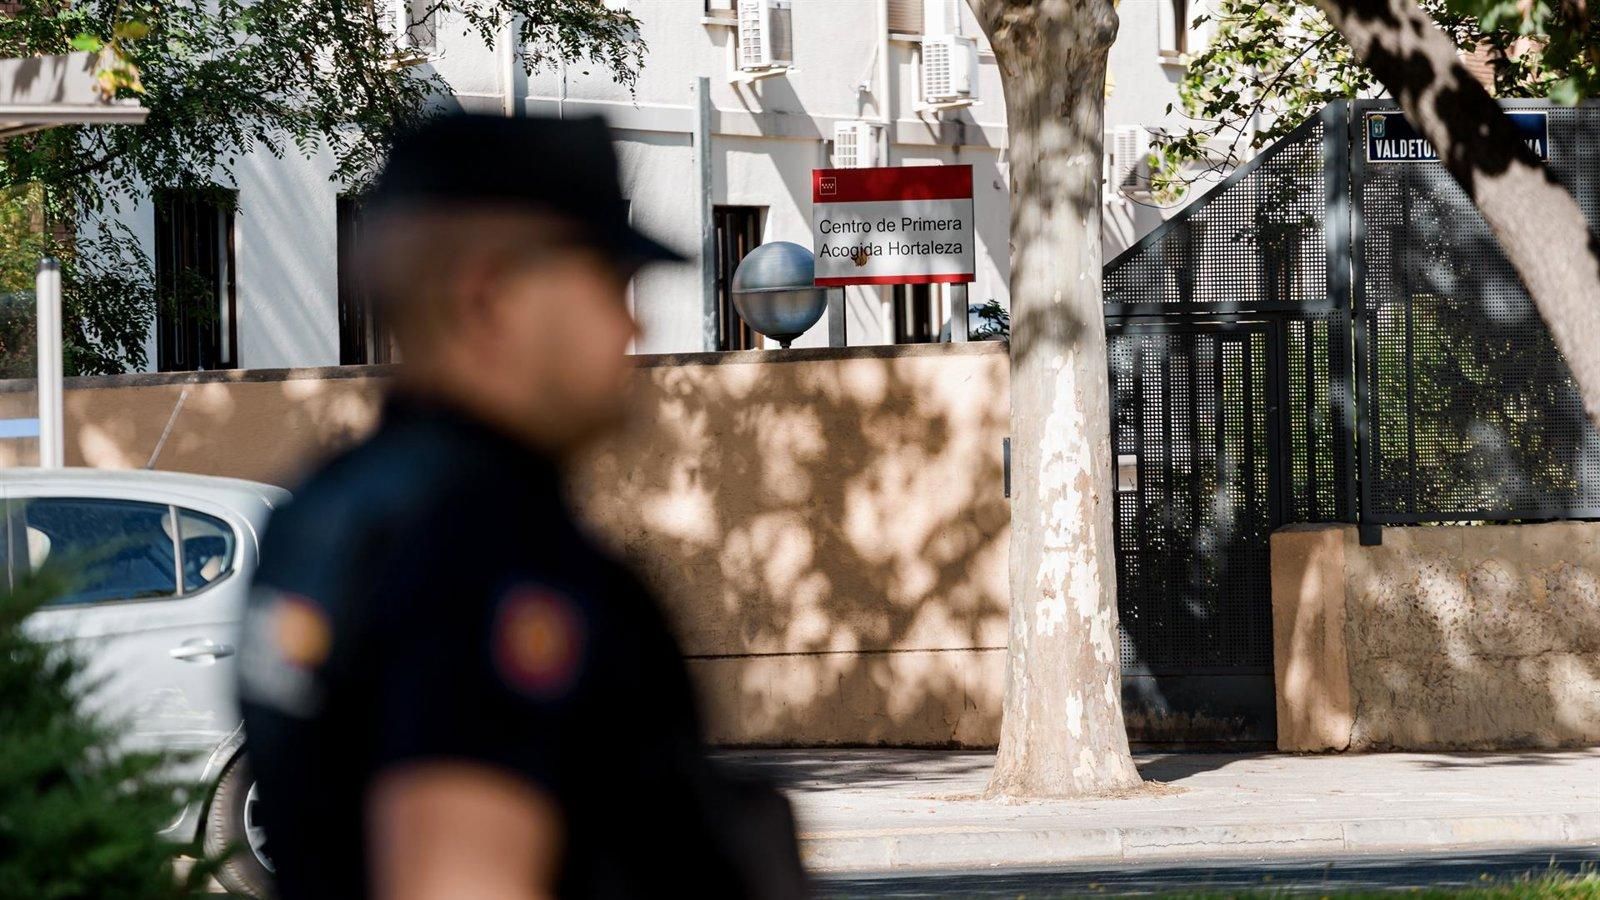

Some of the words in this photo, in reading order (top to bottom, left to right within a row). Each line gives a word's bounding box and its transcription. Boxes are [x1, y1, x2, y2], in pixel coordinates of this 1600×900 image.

[1375, 139, 1438, 158] VALDETO
[819, 219, 872, 234] Centro
[876, 218, 896, 232] de
[901, 217, 962, 232] Primera
[819, 242, 883, 261] Acogida
[888, 240, 963, 256] Hortaleza
